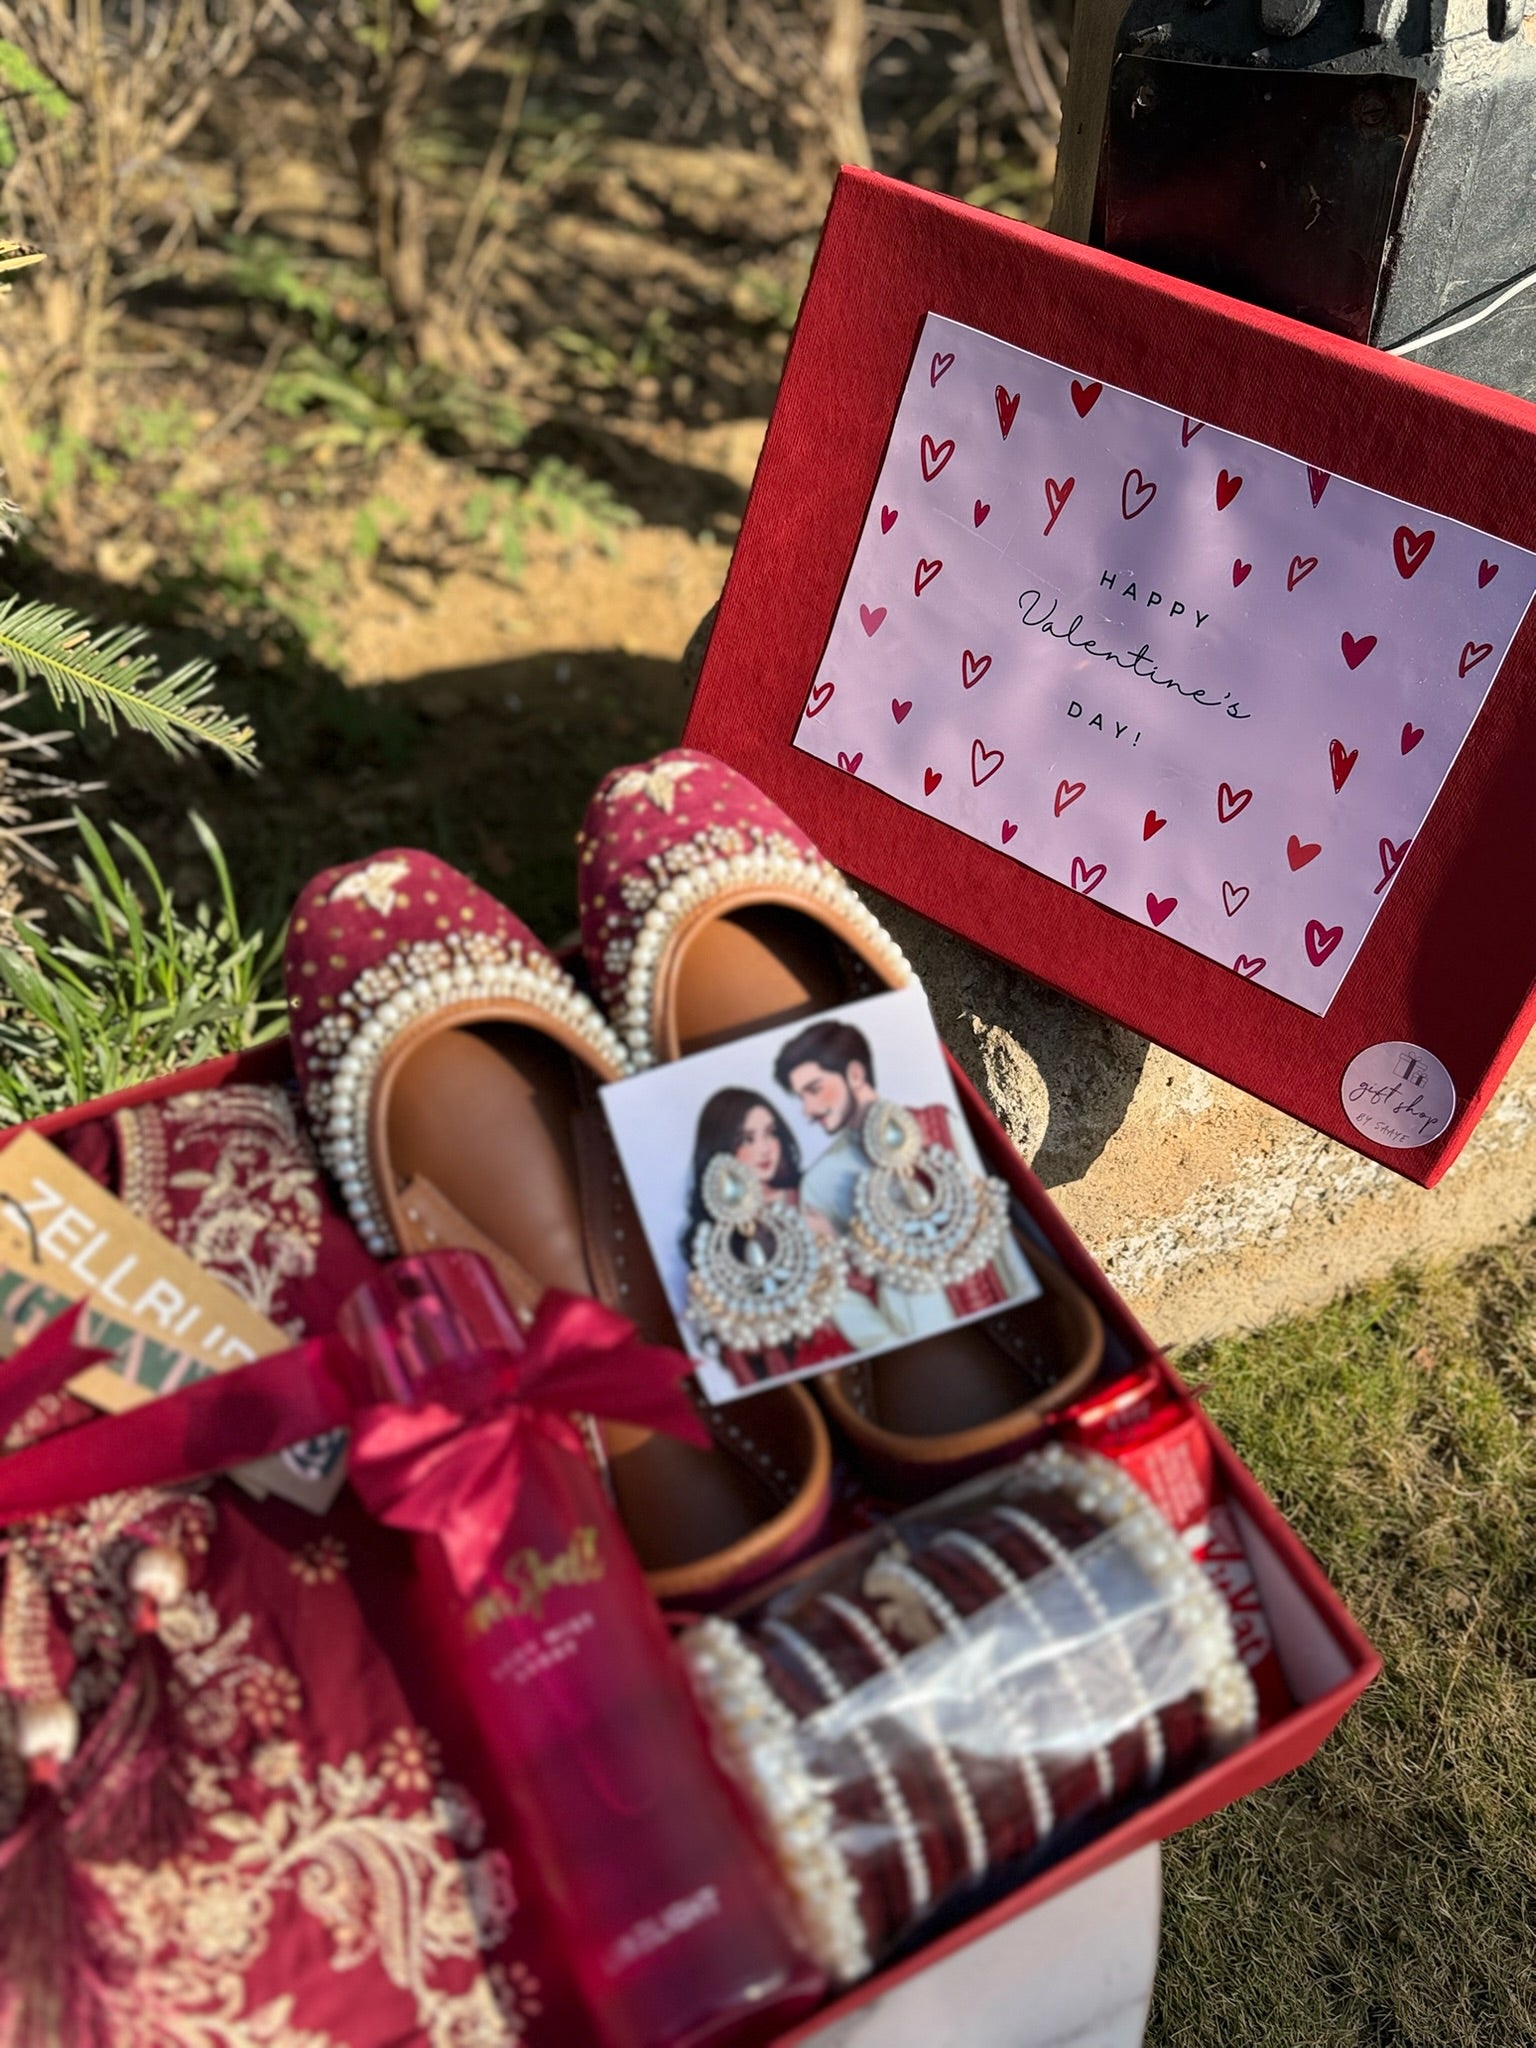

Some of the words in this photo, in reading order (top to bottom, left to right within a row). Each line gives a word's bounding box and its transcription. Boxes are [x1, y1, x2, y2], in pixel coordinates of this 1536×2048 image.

[1100, 570, 1209, 628] HAPPY
[1018, 590, 1251, 718] Valentine's
[1067, 701, 1141, 747] DAY!
[1349, 1081, 1402, 1105] gift
[1393, 1095, 1438, 1134] shop
[1356, 1112, 1372, 1126] BY
